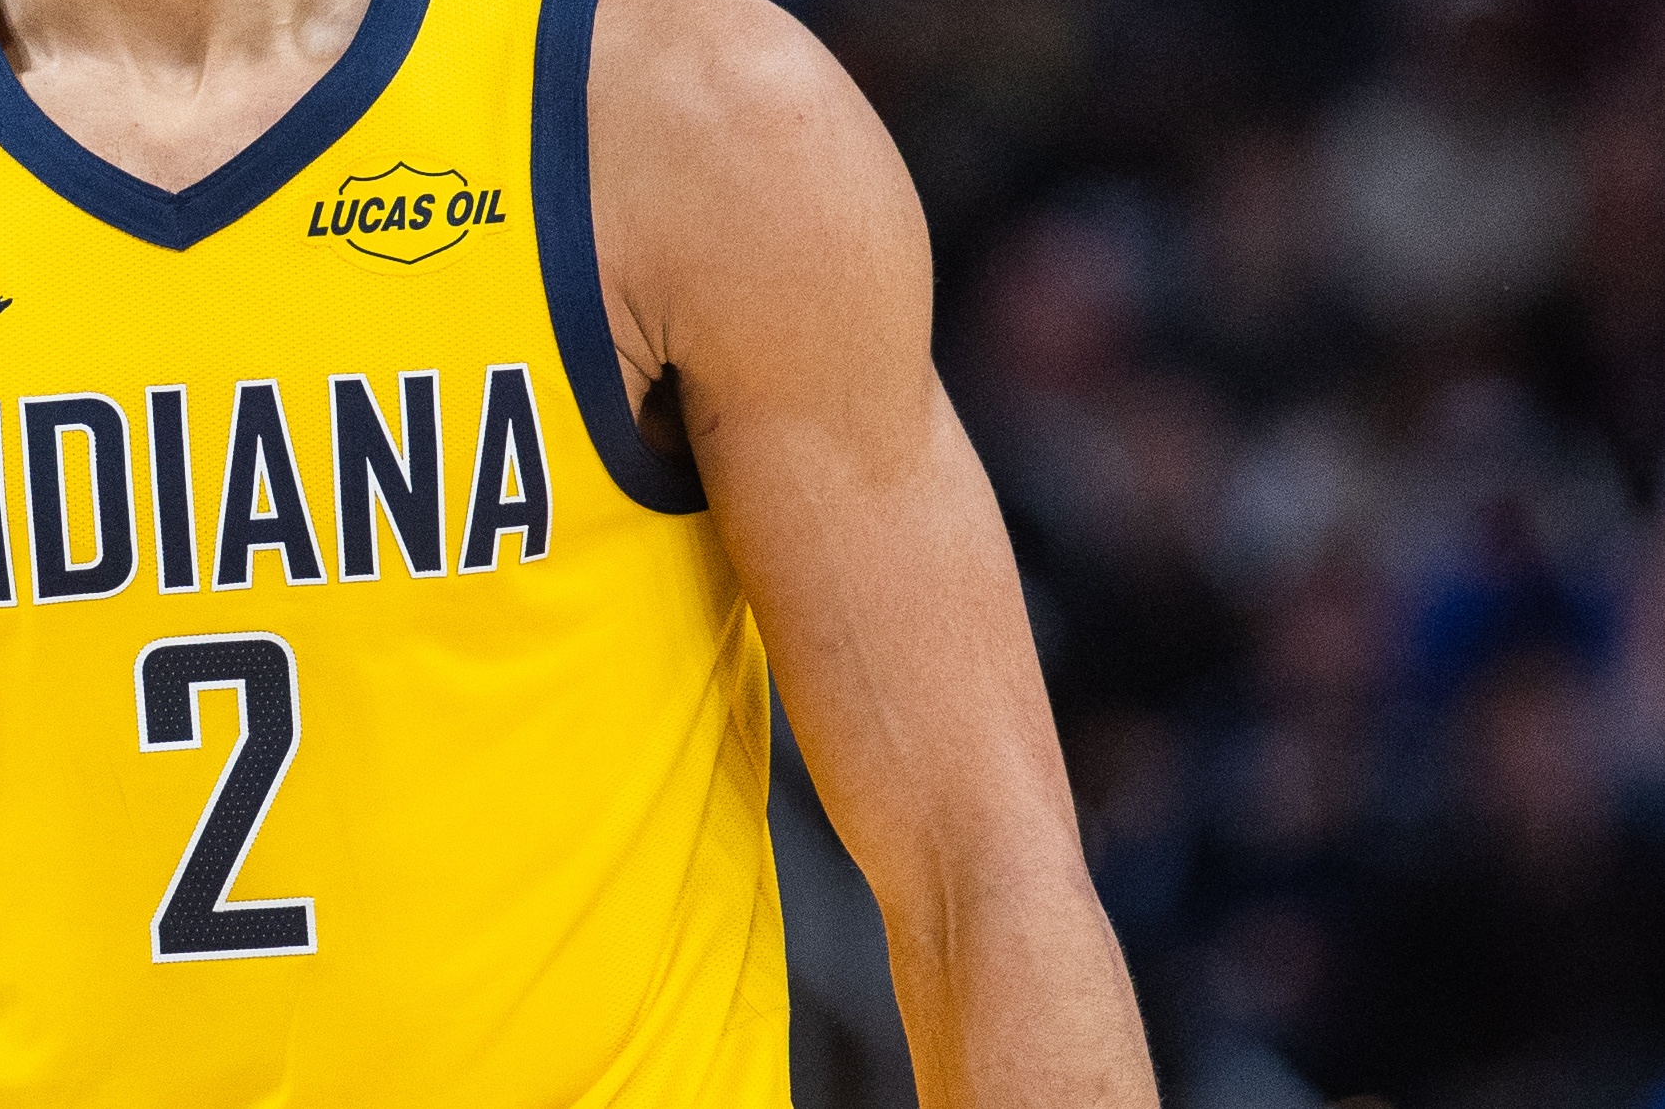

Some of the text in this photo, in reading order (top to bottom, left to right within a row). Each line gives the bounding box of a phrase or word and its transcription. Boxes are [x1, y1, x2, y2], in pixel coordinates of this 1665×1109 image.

[307, 189, 506, 237] LUCAS OIL
[134, 631, 318, 964] 2
